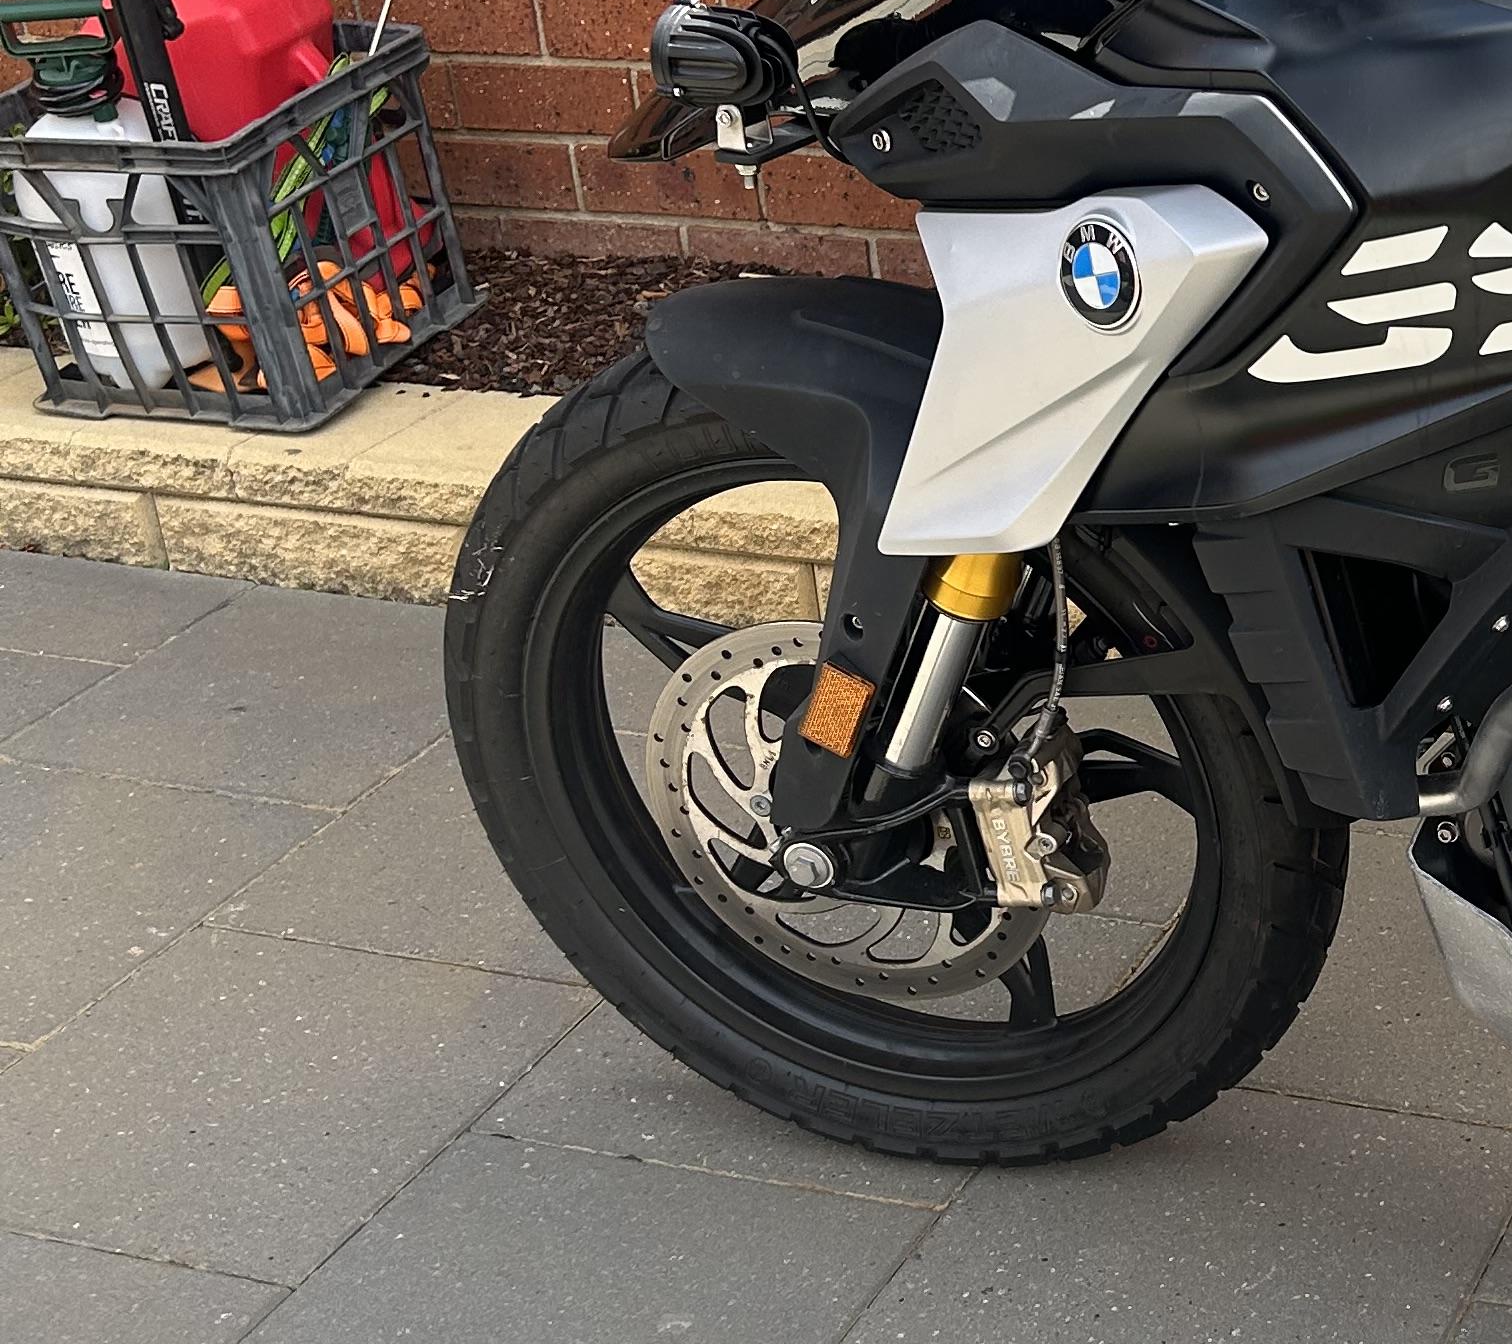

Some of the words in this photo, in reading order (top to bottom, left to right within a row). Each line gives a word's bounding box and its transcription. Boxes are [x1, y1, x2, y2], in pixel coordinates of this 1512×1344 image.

[1063, 224, 1125, 264] BMW
[1443, 453, 1499, 493] G
[991, 818, 1019, 882] BYBRE
